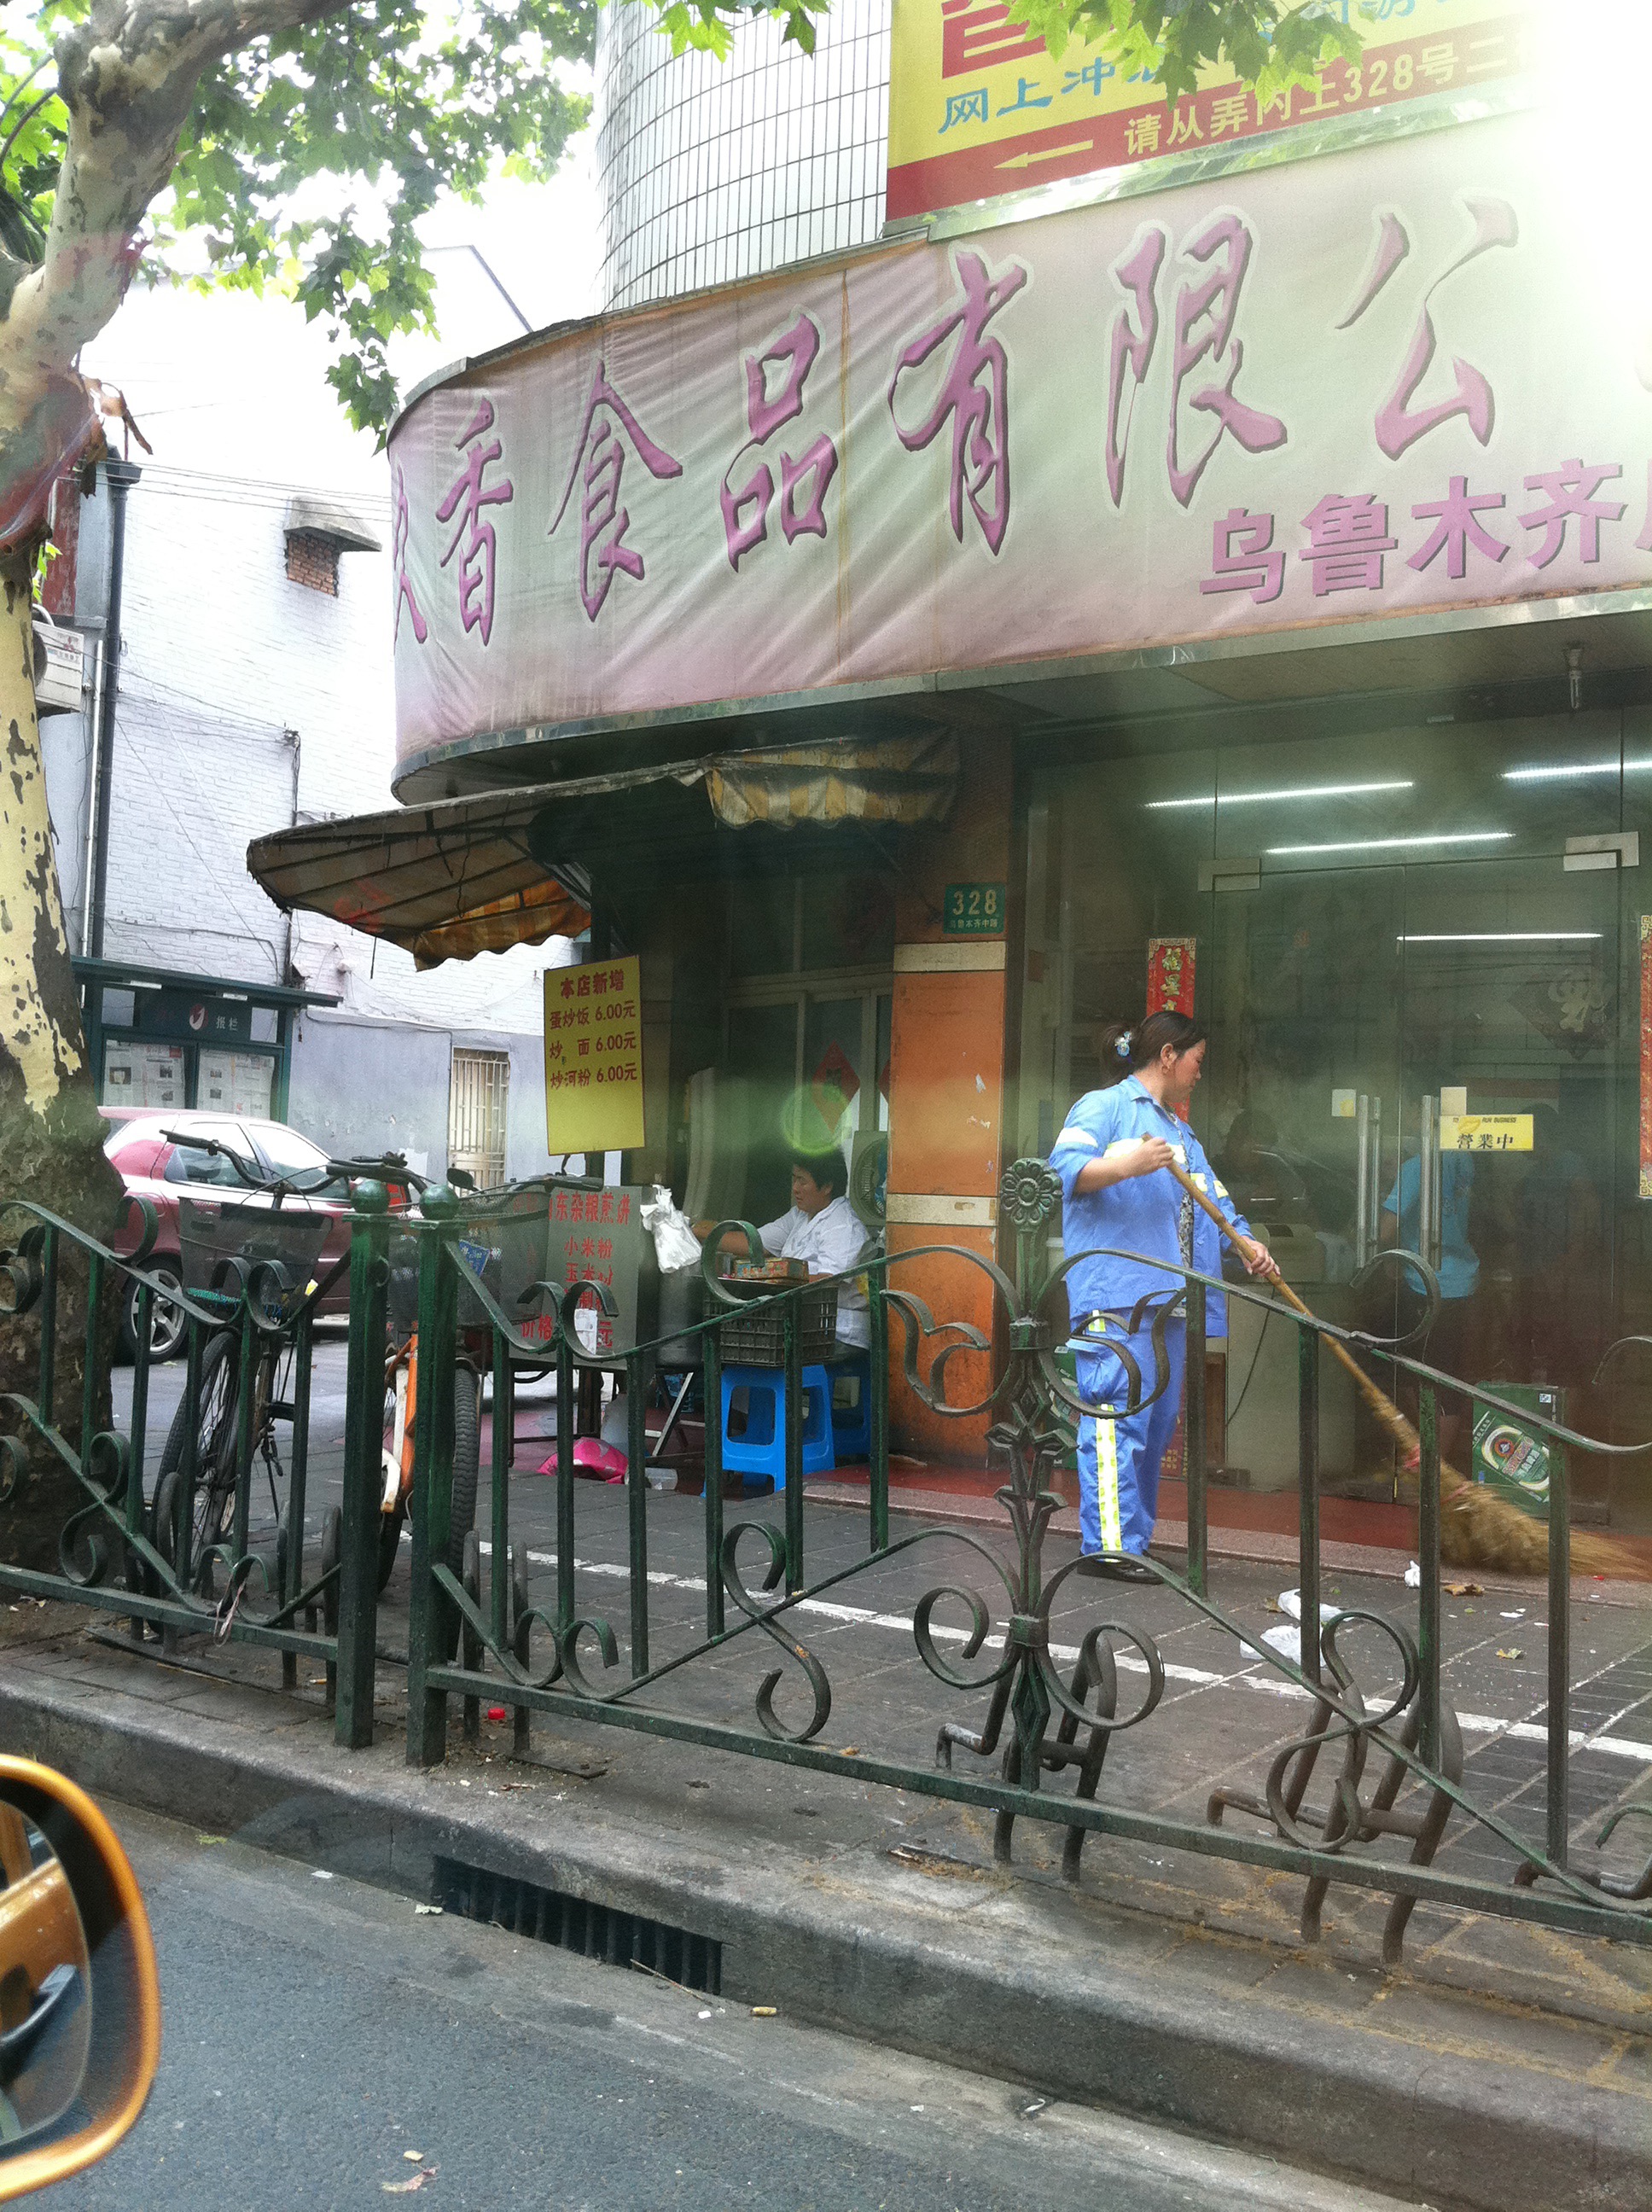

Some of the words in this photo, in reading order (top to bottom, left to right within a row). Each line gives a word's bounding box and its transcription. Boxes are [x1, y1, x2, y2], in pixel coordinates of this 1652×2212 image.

[939, 55, 1162, 135] 网上冲
[393, 195, 1652, 655] 香食品有限公
[1199, 457, 1652, 605] 乌鲁木齐
[952, 889, 997, 916] 328
[560, 969, 625, 999] 本店新增
[550, 1006, 590, 1030] 蛋炒饭
[595, 1000, 637, 1022] 6.00元
[595, 1031, 637, 1053] 6.00元
[596, 1062, 638, 1084] 6.00元
[549, 1190, 631, 1225] 东杂粮煎饼
[564, 1235, 614, 1260] 小米粉
[596, 1321, 614, 1348] 元
